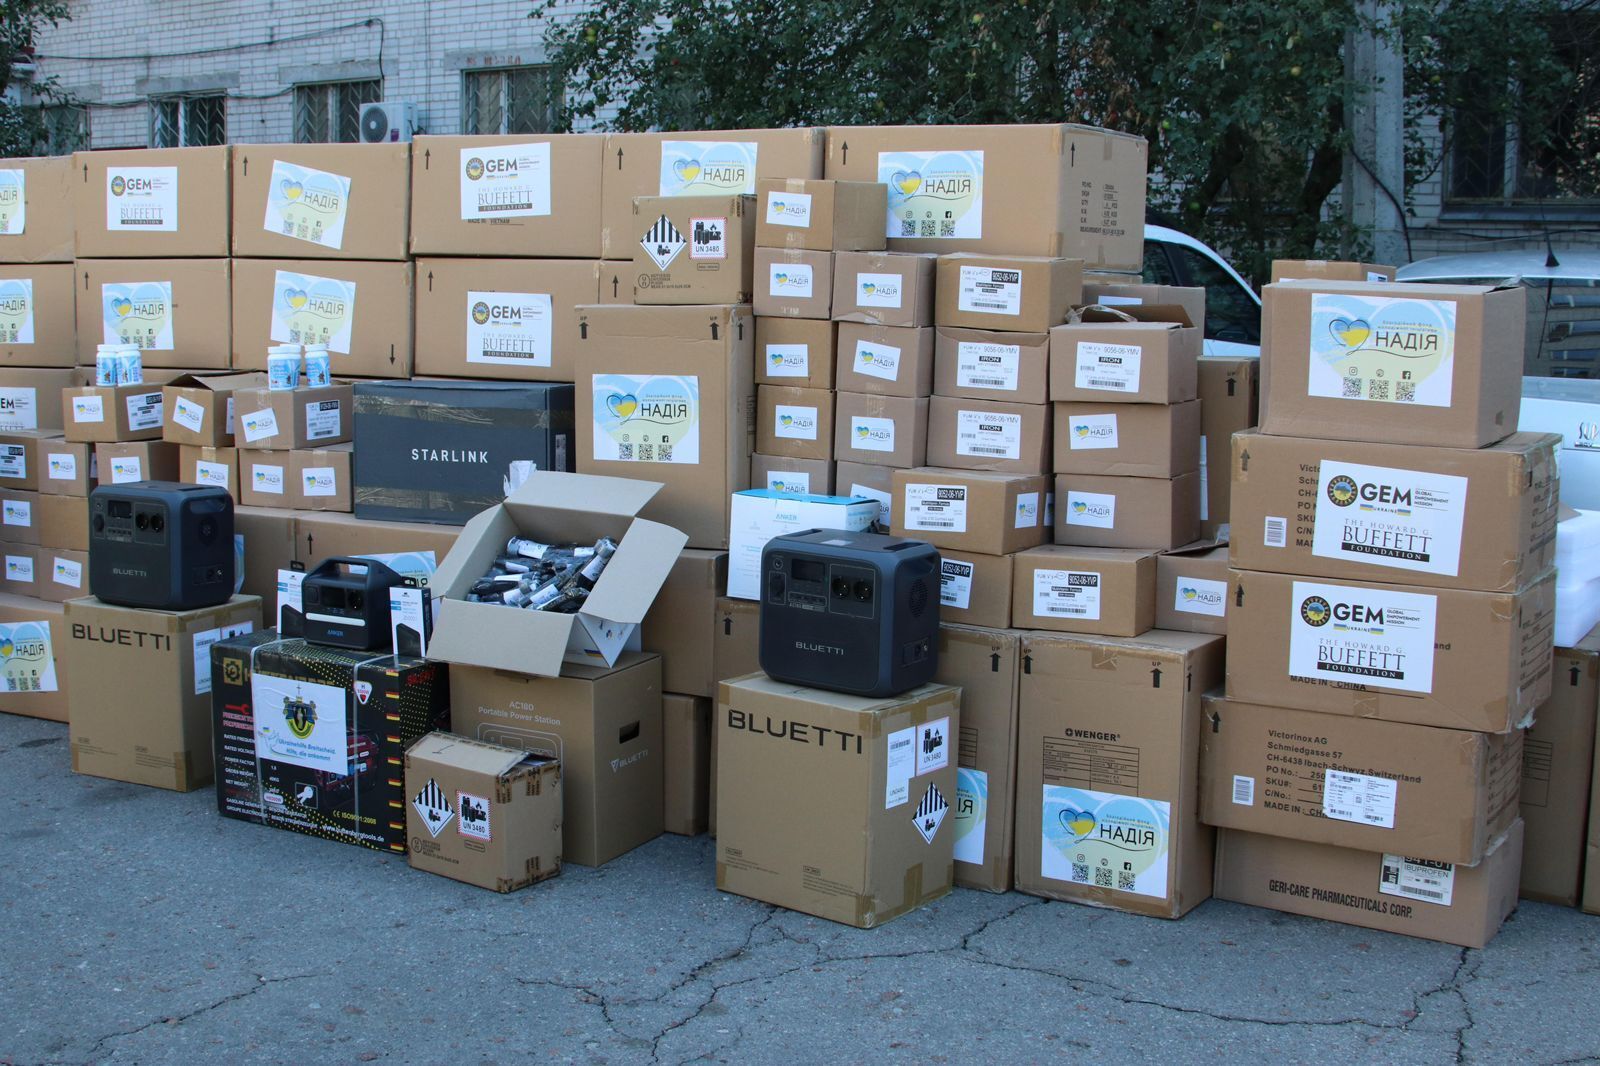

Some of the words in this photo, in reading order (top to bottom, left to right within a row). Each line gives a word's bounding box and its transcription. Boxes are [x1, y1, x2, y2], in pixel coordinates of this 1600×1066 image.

[486, 158, 518, 172] GEM
[704, 168, 744, 182] НАДІЯ
[127, 178, 152, 190] GEM
[925, 179, 971, 194] НАДІЯ
[0, 189, 18, 201] АДІЯ
[304, 191, 339, 210] НАДІЯ
[478, 190, 532, 206] BUFFETT
[120, 207, 164, 220] BUFFETT
[134, 304, 164, 315] НАДІЯ
[309, 299, 344, 316] НАДІЯ
[491, 305, 522, 319] GEM
[483, 338, 535, 352] BUFFETT
[1376, 331, 1438, 351] НАДІЯ
[874, 358, 894, 367] НАДІЯ
[0, 398, 15, 409] EM
[641, 403, 688, 418] НАДІЯ
[411, 448, 488, 464] STARLINK
[1360, 482, 1412, 506] GEM
[1087, 507, 1110, 516] НАДІЯ
[1344, 518, 1364, 526] THE
[1370, 521, 1417, 534] HOWARD
[1342, 525, 1432, 553] BUFFETT
[1350, 544, 1422, 560] FOUNDATION
[113, 568, 147, 577] BLUETTI
[1198, 594, 1222, 603] НАДІЯ
[1333, 602, 1384, 625] GEM
[72, 624, 170, 651] BLUETTI
[16, 643, 45, 656] НАДІЯ
[795, 641, 844, 655] BLUETTI
[1345, 640, 1390, 652] HOWARD
[1318, 645, 1406, 670] BUFFETT
[1326, 663, 1396, 678] FOUNDATION
[478, 706, 508, 718] Portable
[510, 712, 532, 722] Power
[534, 715, 561, 726] Station
[728, 709, 862, 754] BLUETTI
[1074, 729, 1116, 742] WENGER
[1268, 729, 1313, 744] Victorinox
[1314, 736, 1328, 745] AG
[930, 752, 942, 761] 3480
[1267, 741, 1331, 759] Schmiedgasse
[1332, 752, 1343, 760] 57
[620, 750, 648, 768] BLUETTI
[1266, 753, 1303, 766] CH-6438
[1266, 765, 1279, 774] PO
[1310, 771, 1325, 780] 250
[1265, 778, 1292, 789] SKU#:
[1264, 801, 1290, 812] MADE
[1291, 804, 1300, 813] IN
[472, 824, 486, 833] 3480
[1100, 823, 1154, 846] НАДІЯ
[1404, 864, 1449, 878] IBUPROFEN
[1269, 879, 1310, 898] GERI-CARE
[1312, 888, 1387, 914] PHARMACEUTICALS
[1390, 904, 1413, 919] CORP.
